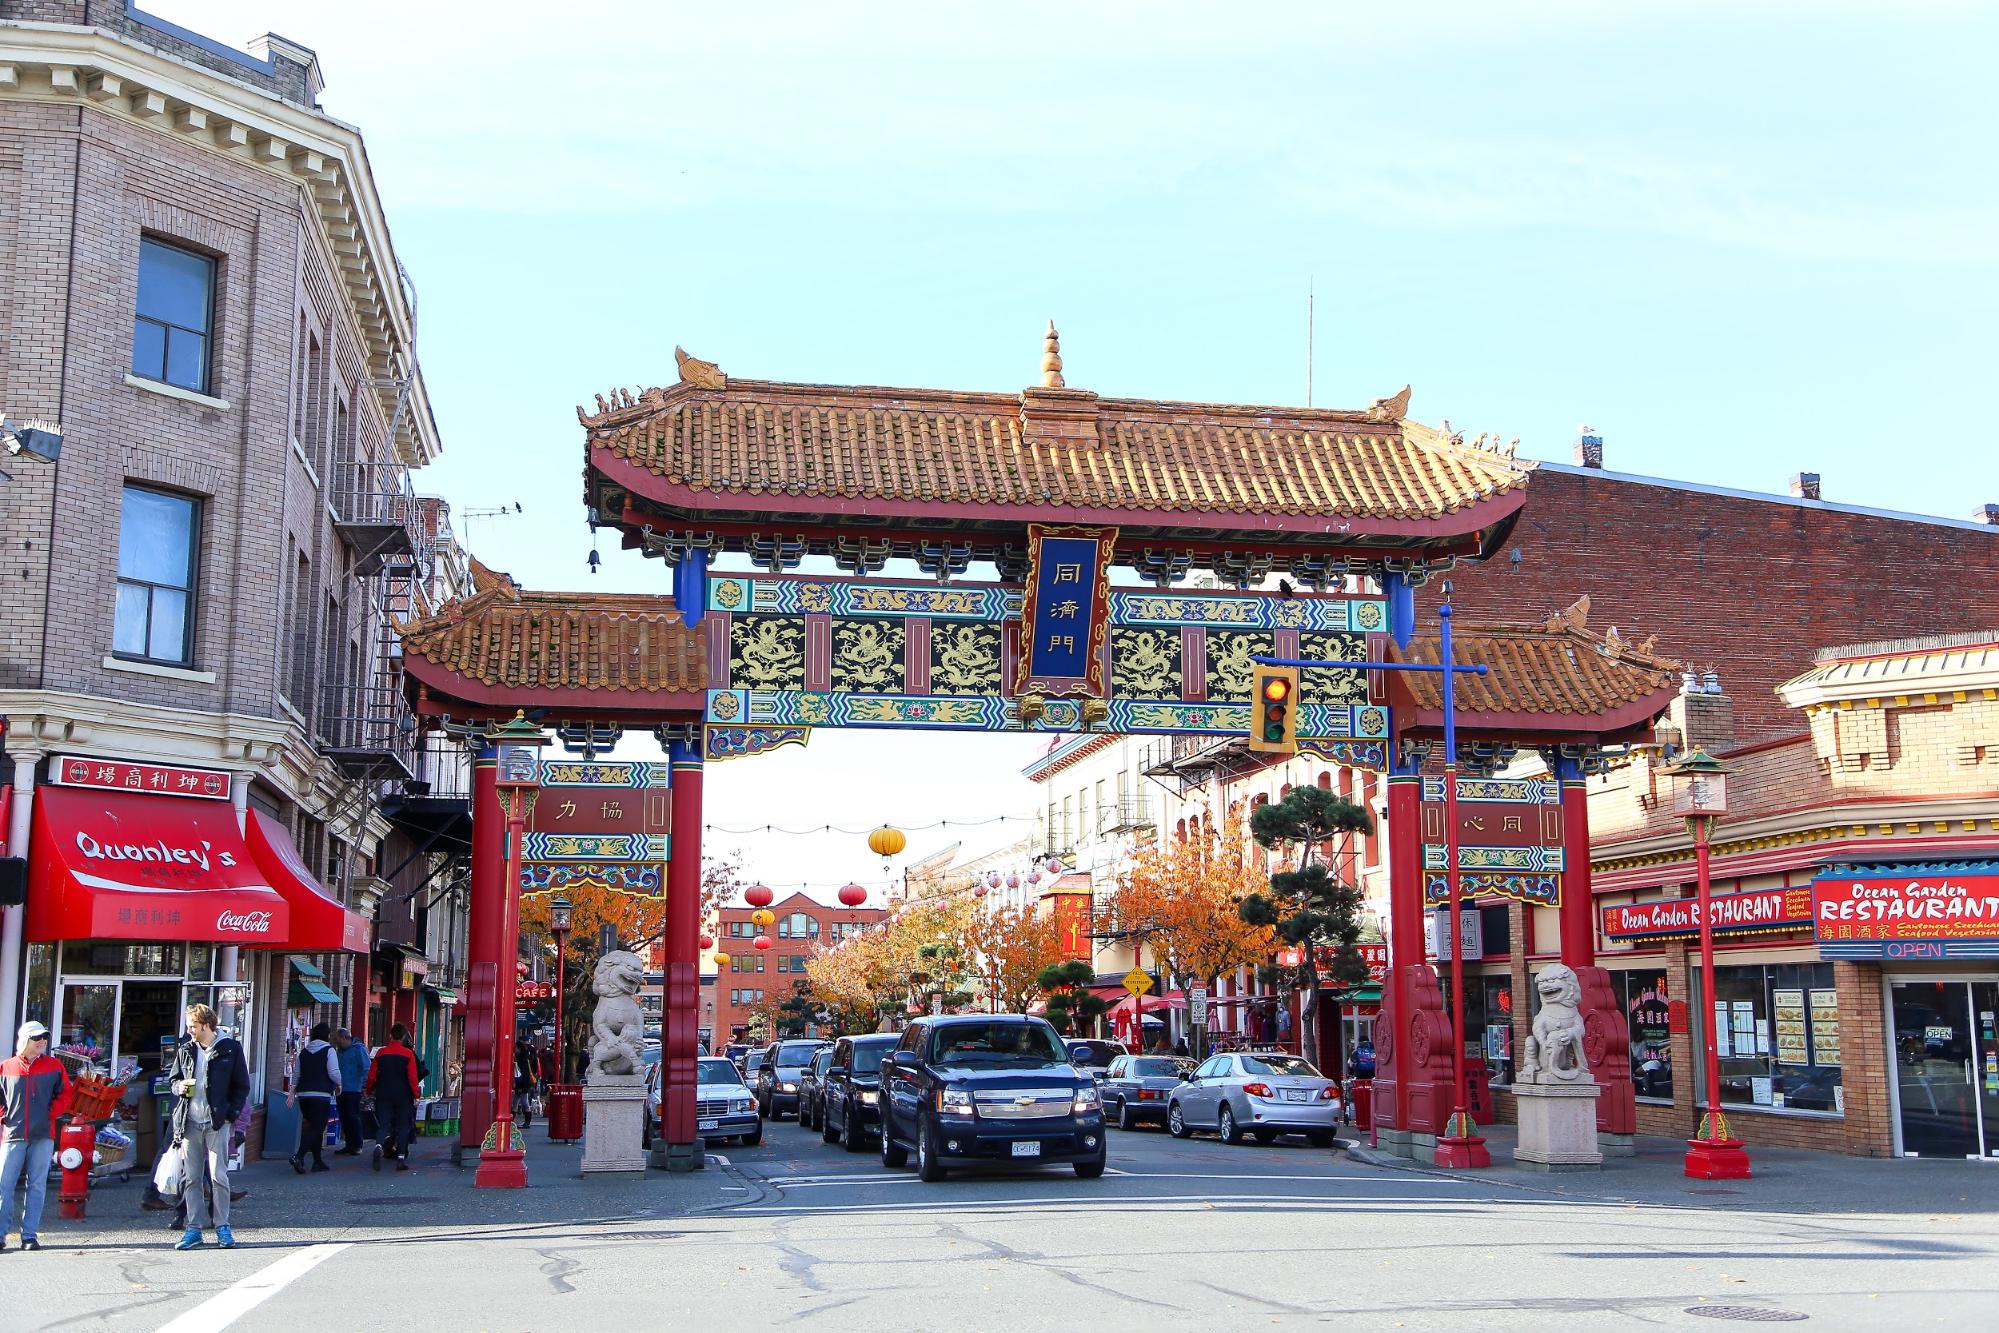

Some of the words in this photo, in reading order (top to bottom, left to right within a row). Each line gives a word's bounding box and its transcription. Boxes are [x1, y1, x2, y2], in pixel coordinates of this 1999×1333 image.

[76, 831, 236, 871] Quanley's
[1852, 883, 1900, 899] Ocean
[1905, 881, 1967, 899] Garden
[1621, 908, 1649, 929] Ocean
[1652, 905, 1686, 926] Garden
[1690, 895, 1782, 925] RSTAURANT
[1820, 896, 1999, 921] RESTAURANT
[216, 909, 273, 933] Coca-Cola
[1896, 921, 1950, 930] Cantonese
[1896, 929, 1939, 938] Seafood
[1944, 929, 1999, 938] Vegetaria
[1887, 943, 1942, 957] OPEN
[1926, 1030, 1952, 1040] OPEN
